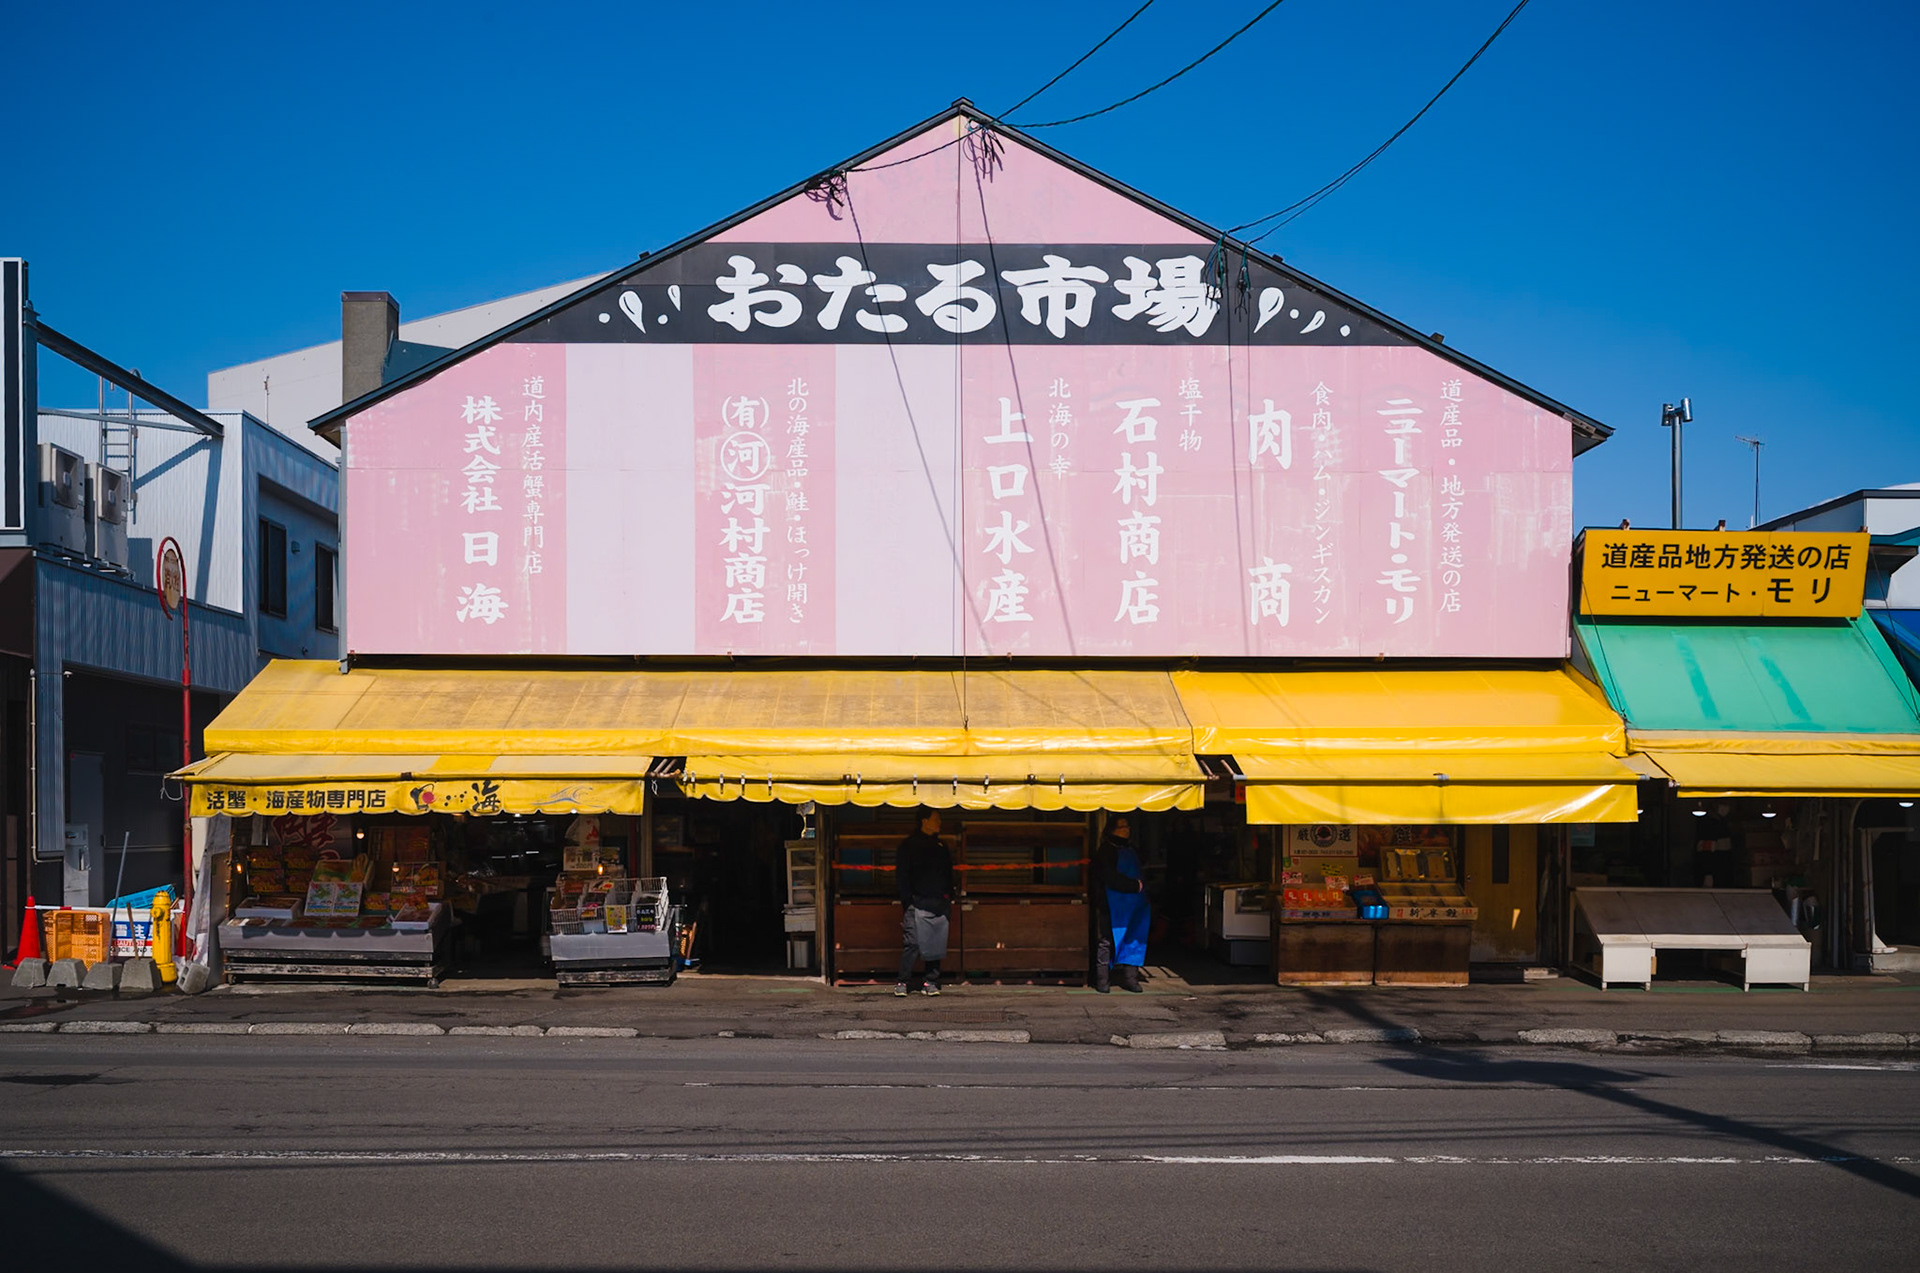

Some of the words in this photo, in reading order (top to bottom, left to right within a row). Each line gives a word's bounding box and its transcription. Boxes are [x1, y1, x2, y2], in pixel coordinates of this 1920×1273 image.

[708, 254, 1223, 338] おたる市場
[1049, 377, 1073, 480] 北海の幸
[1178, 377, 1203, 452] 塩干物
[522, 376, 545, 576] 道内産活蟹専門店
[982, 397, 1035, 623] 上口水産
[1112, 398, 1165, 625] 石村商店
[1376, 398, 1424, 624] ニューマート・モリ
[1601, 542, 1852, 570] 道産品地方発送の店
[1611, 576, 1832, 604] ニューマート・モリ
[207, 789, 386, 810] 活蟹・海産物専門店
